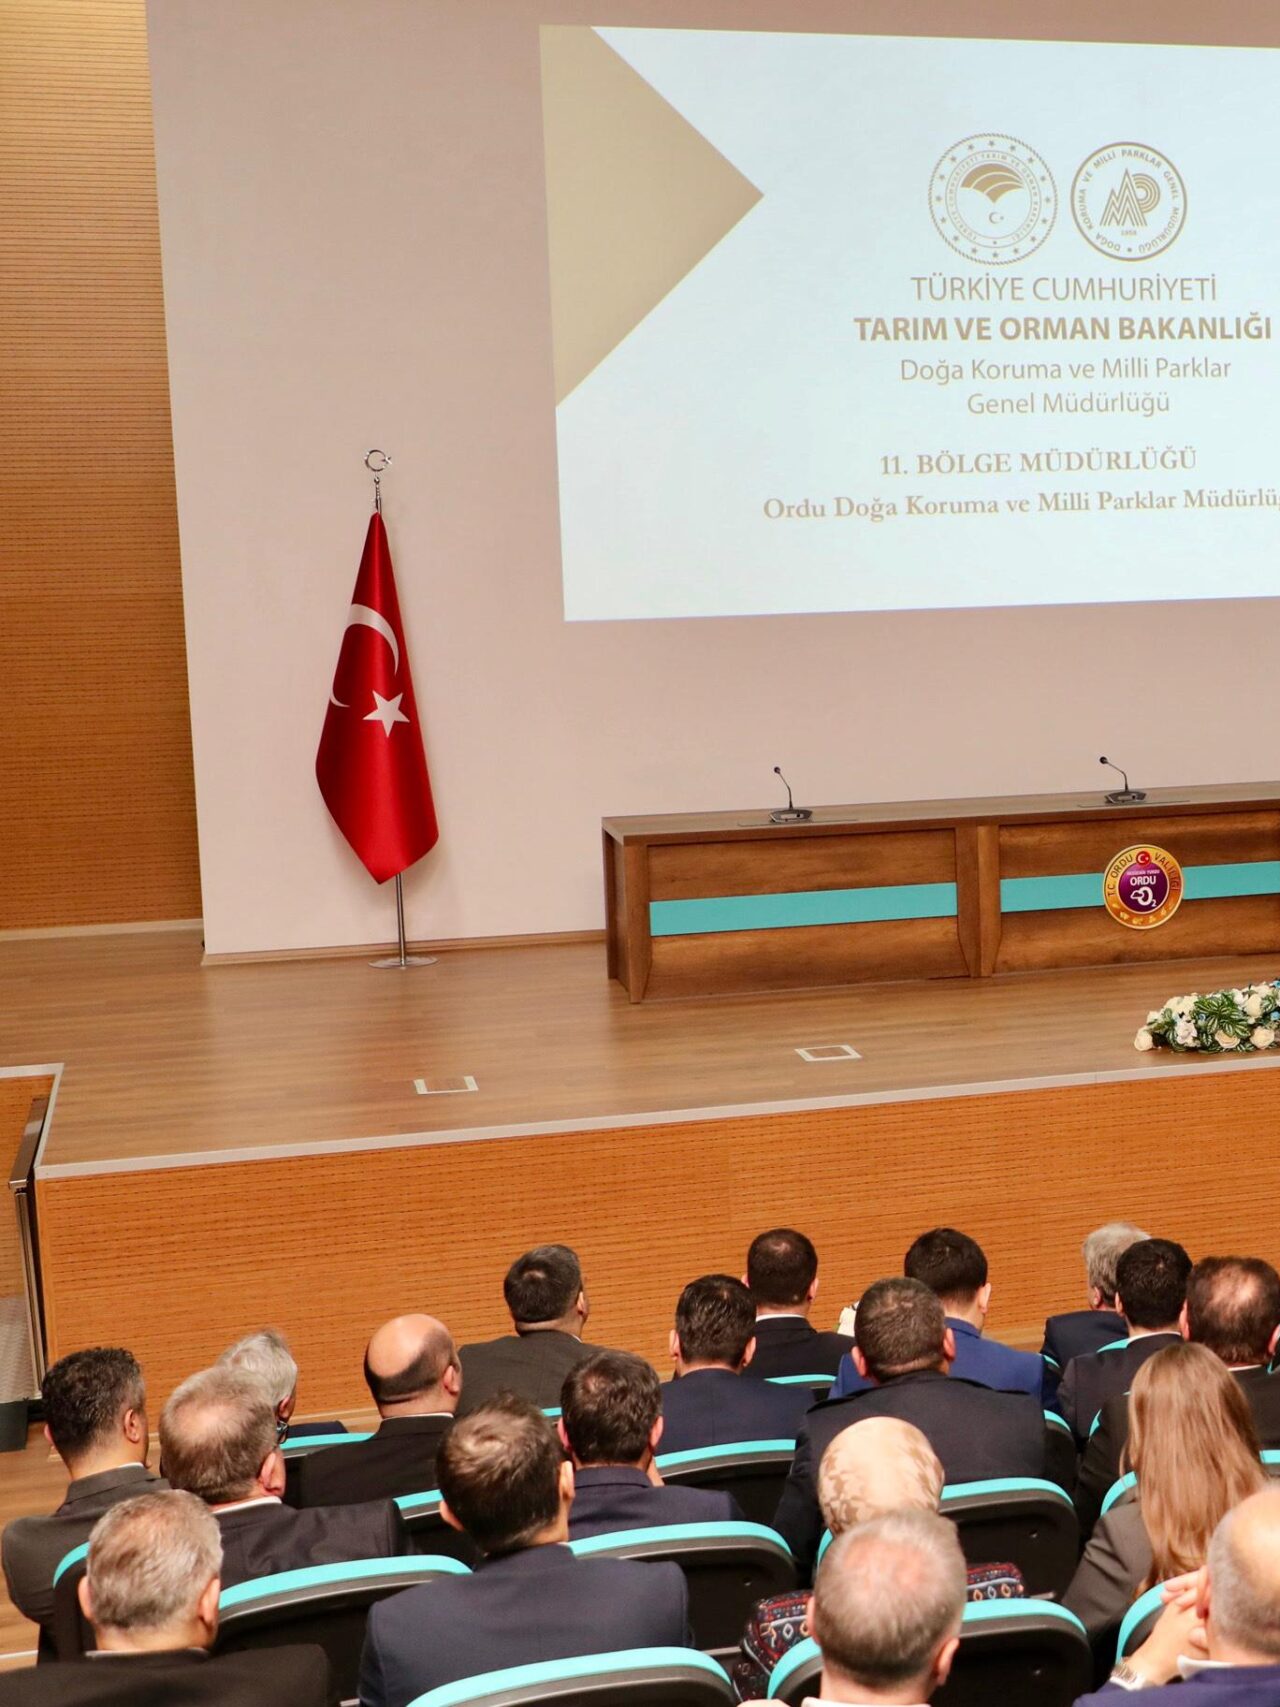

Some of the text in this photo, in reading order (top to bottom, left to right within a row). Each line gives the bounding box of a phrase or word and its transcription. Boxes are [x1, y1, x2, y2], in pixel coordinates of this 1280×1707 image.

[909, 272, 1217, 302] TÜRKİYE CUMHURİYETİ
[853, 312, 1272, 342] TARIM VE ORMAN BAKANLIĞI
[900, 356, 1232, 386] Doğa Koruma ve Milli Parklar
[967, 391, 1170, 418] Genel Müdürlüğü
[880, 445, 1197, 476] 11. BÖLGE MÜDÜRLÜĞÜ
[763, 498, 827, 519] Ordu
[833, 496, 899, 523] Doğa
[905, 495, 1000, 516] Koruma
[1006, 499, 1031, 513] ve
[1037, 491, 1091, 512] Milli
[1097, 490, 1177, 511] Parklar
[1112, 853, 1133, 878] ORDU
[1129, 875, 1157, 886] ORDU
